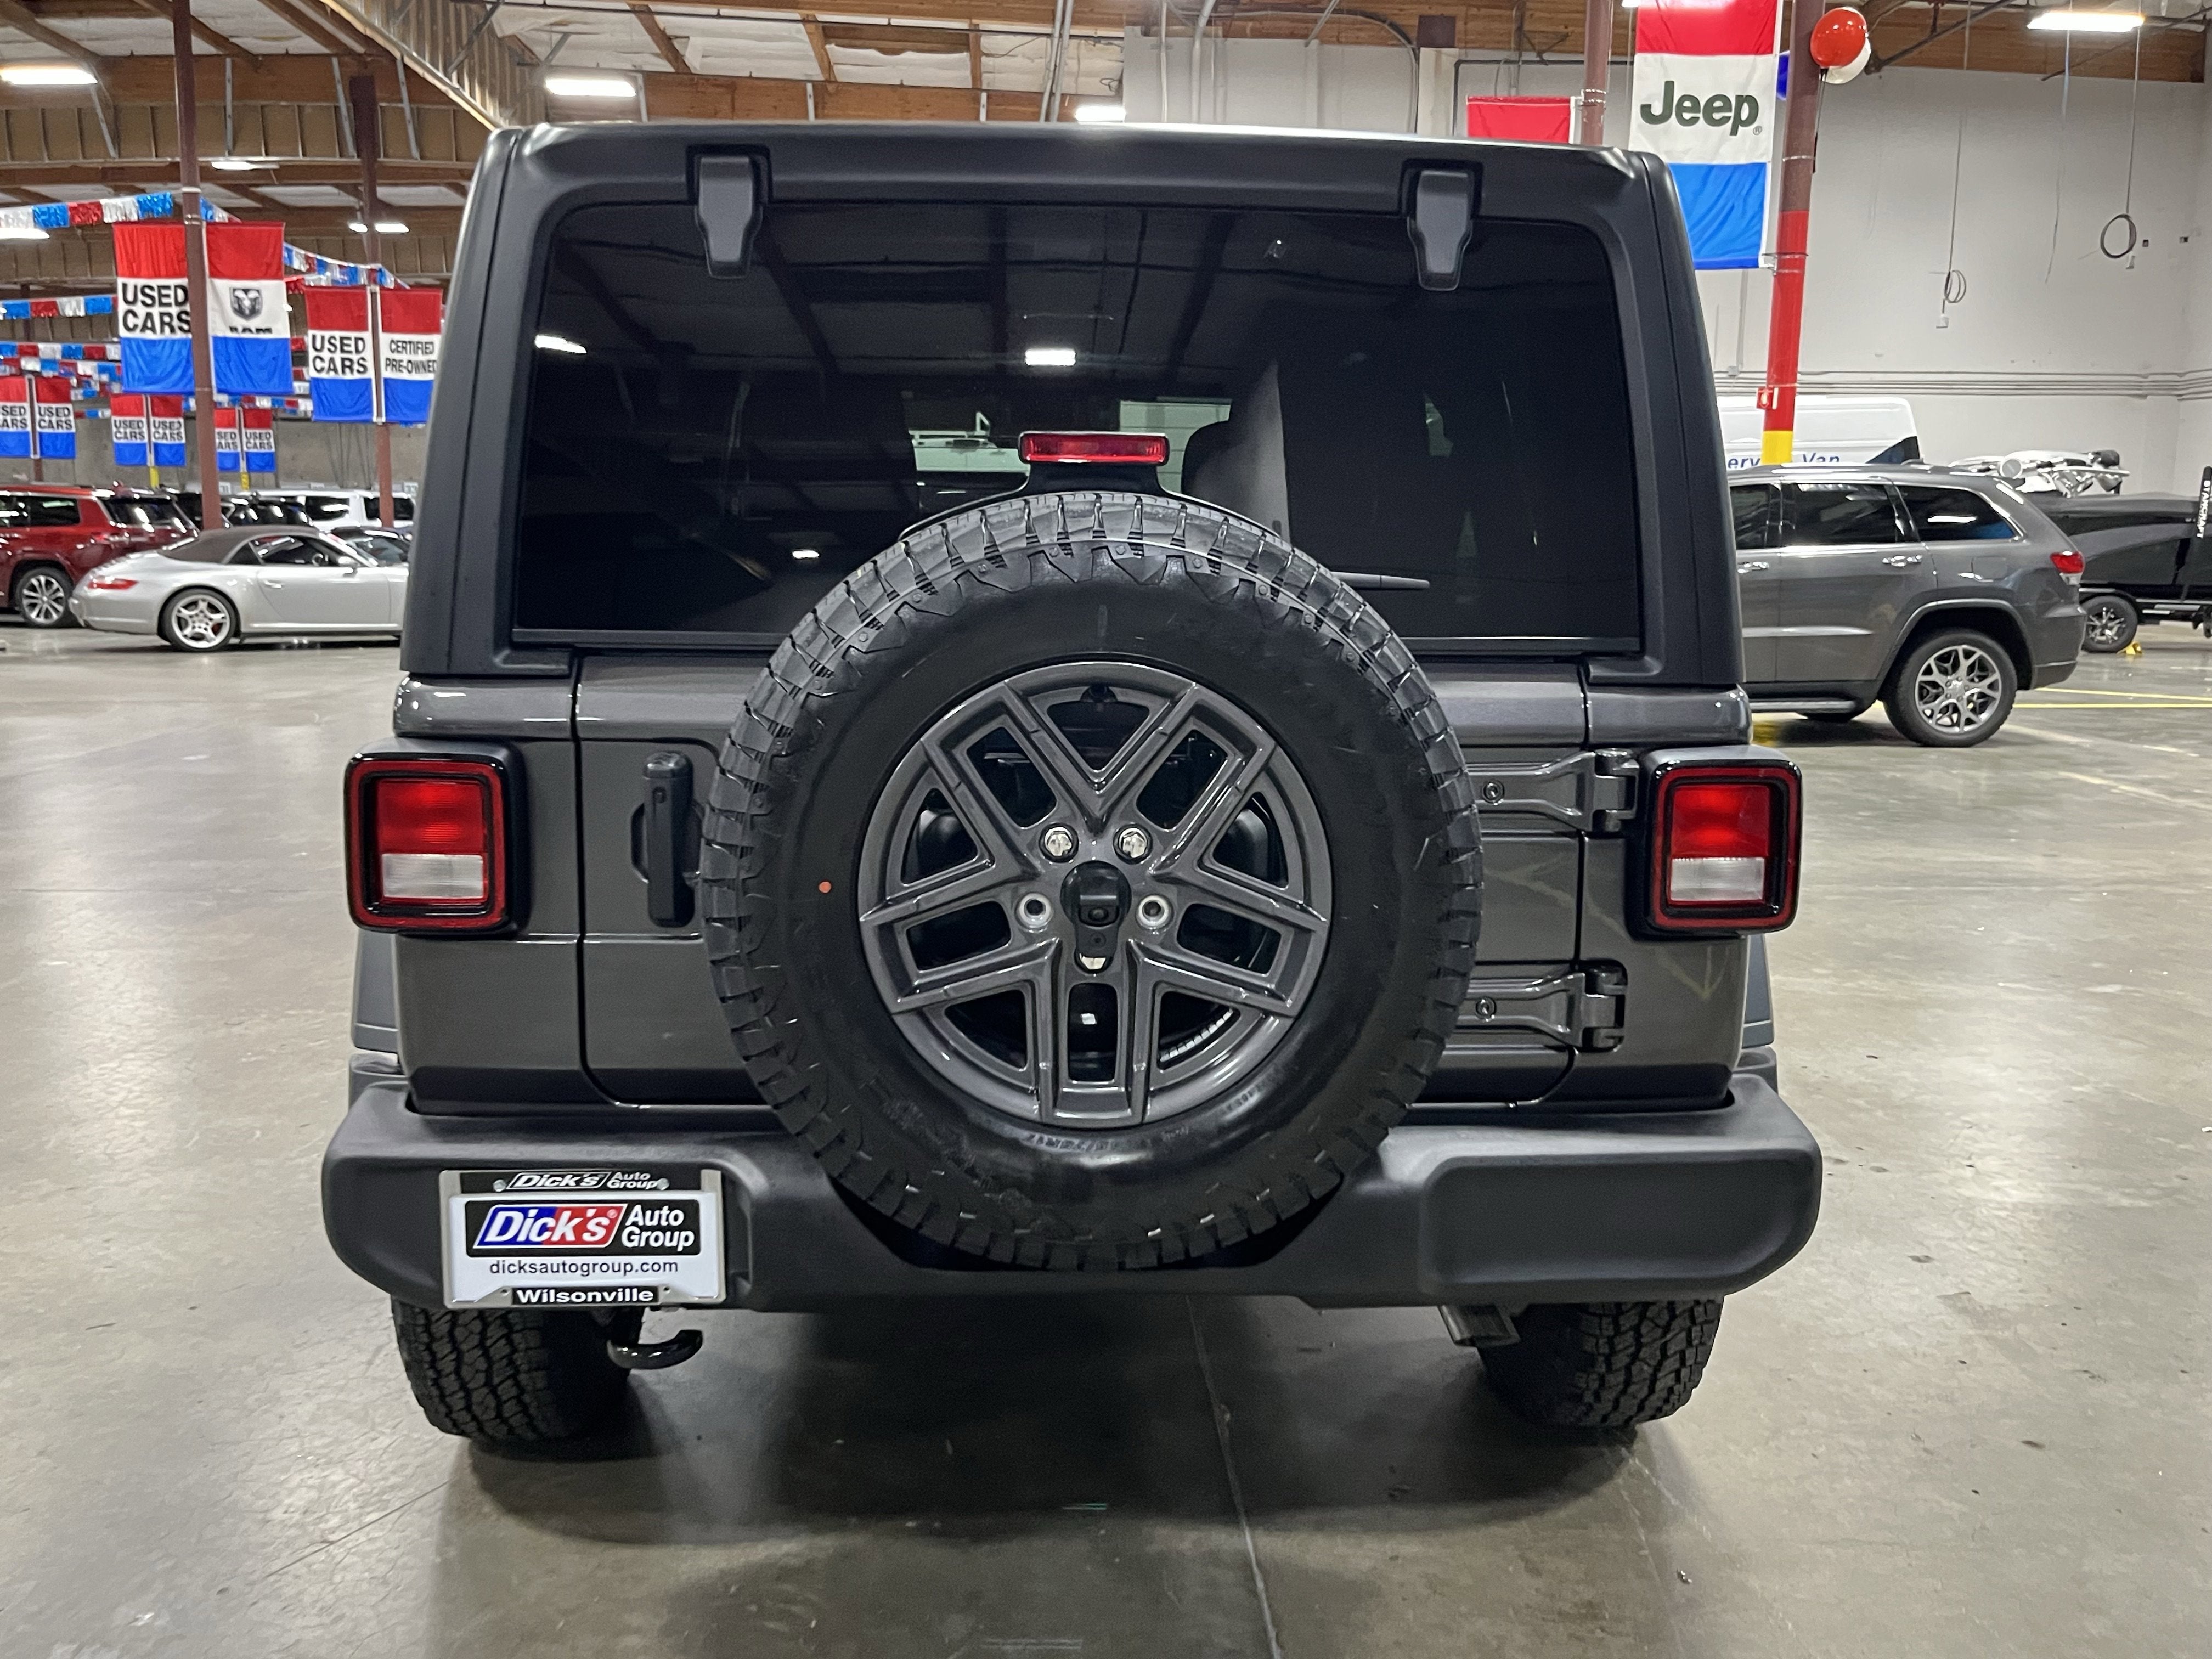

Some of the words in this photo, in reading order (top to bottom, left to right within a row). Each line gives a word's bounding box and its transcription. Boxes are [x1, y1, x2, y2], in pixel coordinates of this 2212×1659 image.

[1640, 81, 1759, 136] Jeep
[122, 283, 189, 308] USED
[122, 309, 191, 334] CARS
[312, 334, 366, 355] USED
[390, 339, 435, 355] CERTIFIED
[312, 356, 368, 376] CARS
[1, 405, 26, 416] SED
[38, 405, 71, 417] USED
[0, 417, 28, 428] ARS
[38, 419, 72, 430] CARS
[114, 419, 144, 429] USED
[153, 420, 182, 431] USED
[114, 430, 145, 440] CARS
[154, 430, 183, 441] CARS
[217, 431, 237, 440] SED
[245, 431, 272, 440] USED
[217, 441, 238, 449] ARS
[245, 441, 273, 450] CARS
[514, 1173, 600, 1187] Dick's
[611, 1172, 651, 1180] Auto
[606, 1180, 658, 1190] Group
[624, 1205, 685, 1227] Auto
[483, 1207, 611, 1243] Dick's
[621, 1226, 695, 1252] Group
[489, 1260, 679, 1277] dicksautogroup.com
[516, 1287, 654, 1305] Wilsonville
